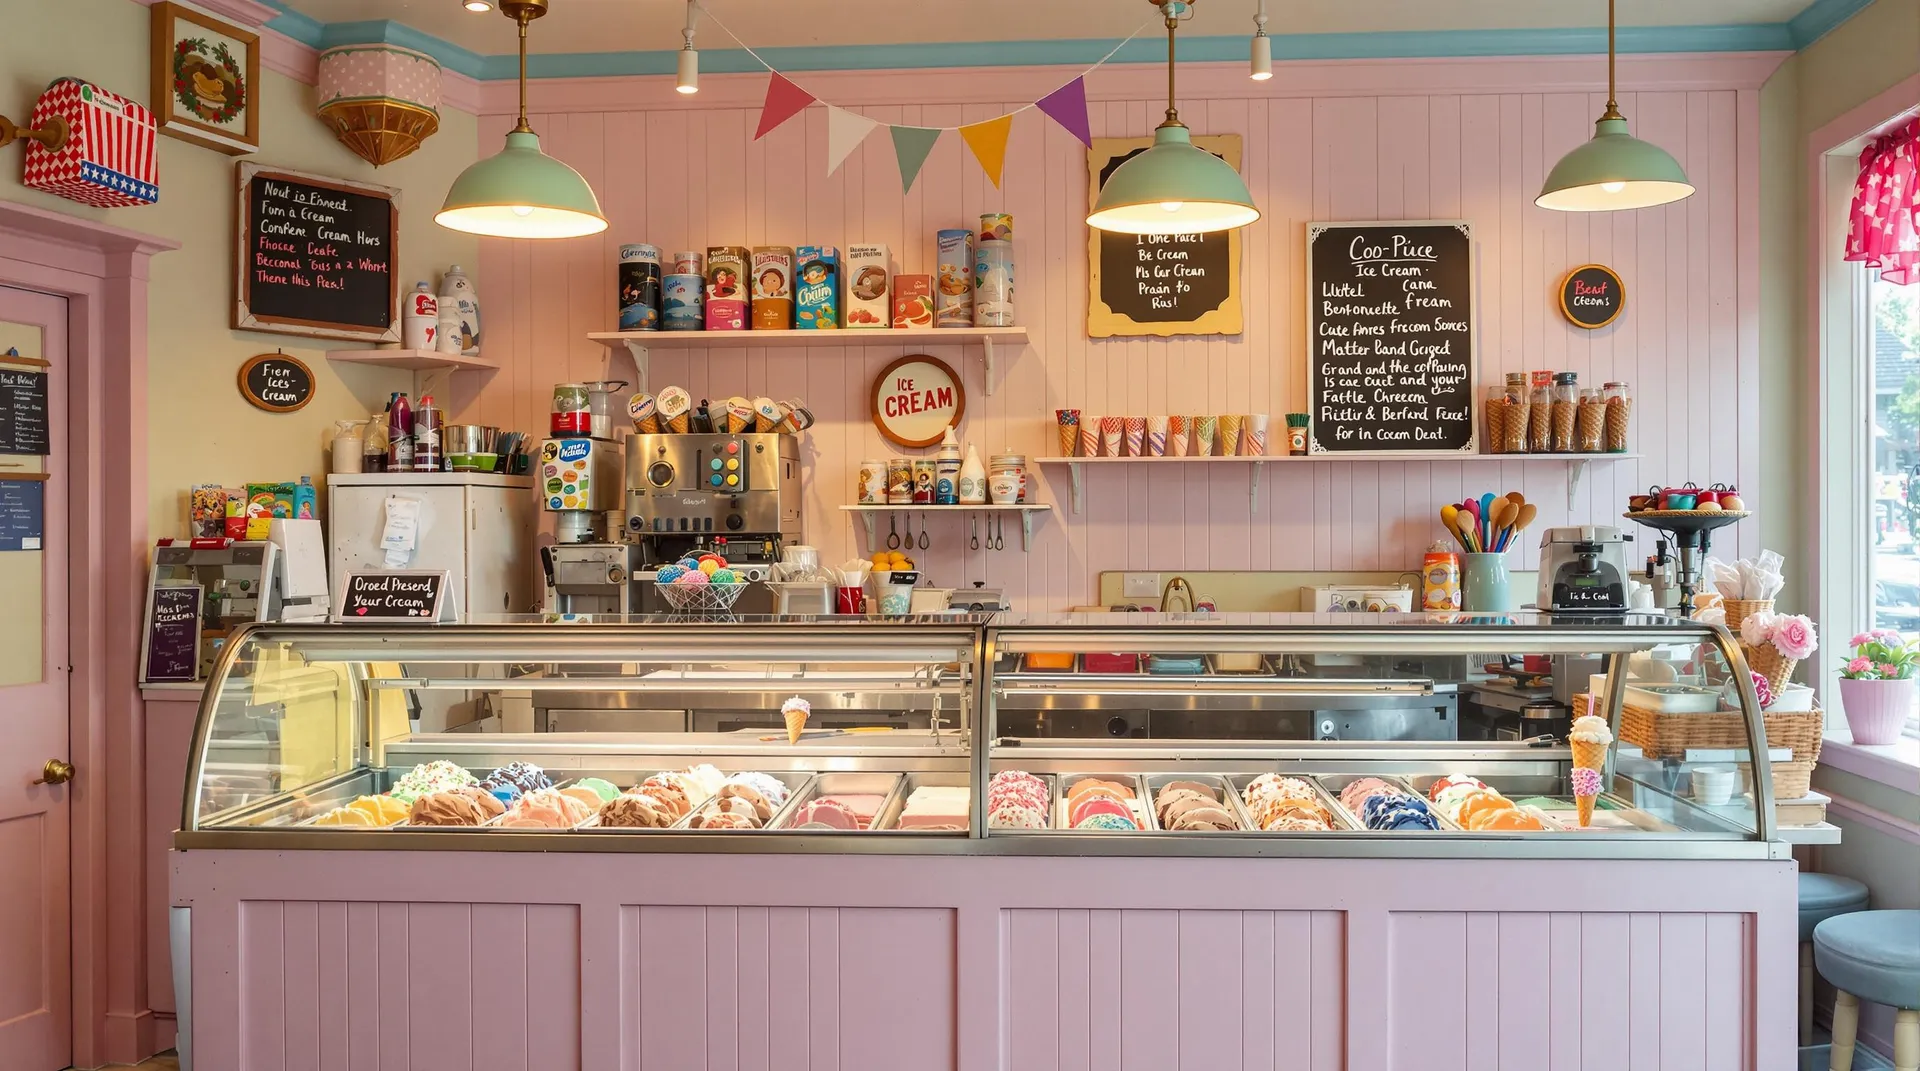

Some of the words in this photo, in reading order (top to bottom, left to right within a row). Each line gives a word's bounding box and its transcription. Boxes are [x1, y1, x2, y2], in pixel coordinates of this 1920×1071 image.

[1355, 264, 1378, 277] Ice
[1381, 263, 1422, 277] Cream
[1389, 359, 1411, 374] the
[897, 377, 915, 392] ICE
[1399, 373, 1427, 386] and
[884, 386, 953, 418] CREAM
[1365, 405, 1376, 421] &
